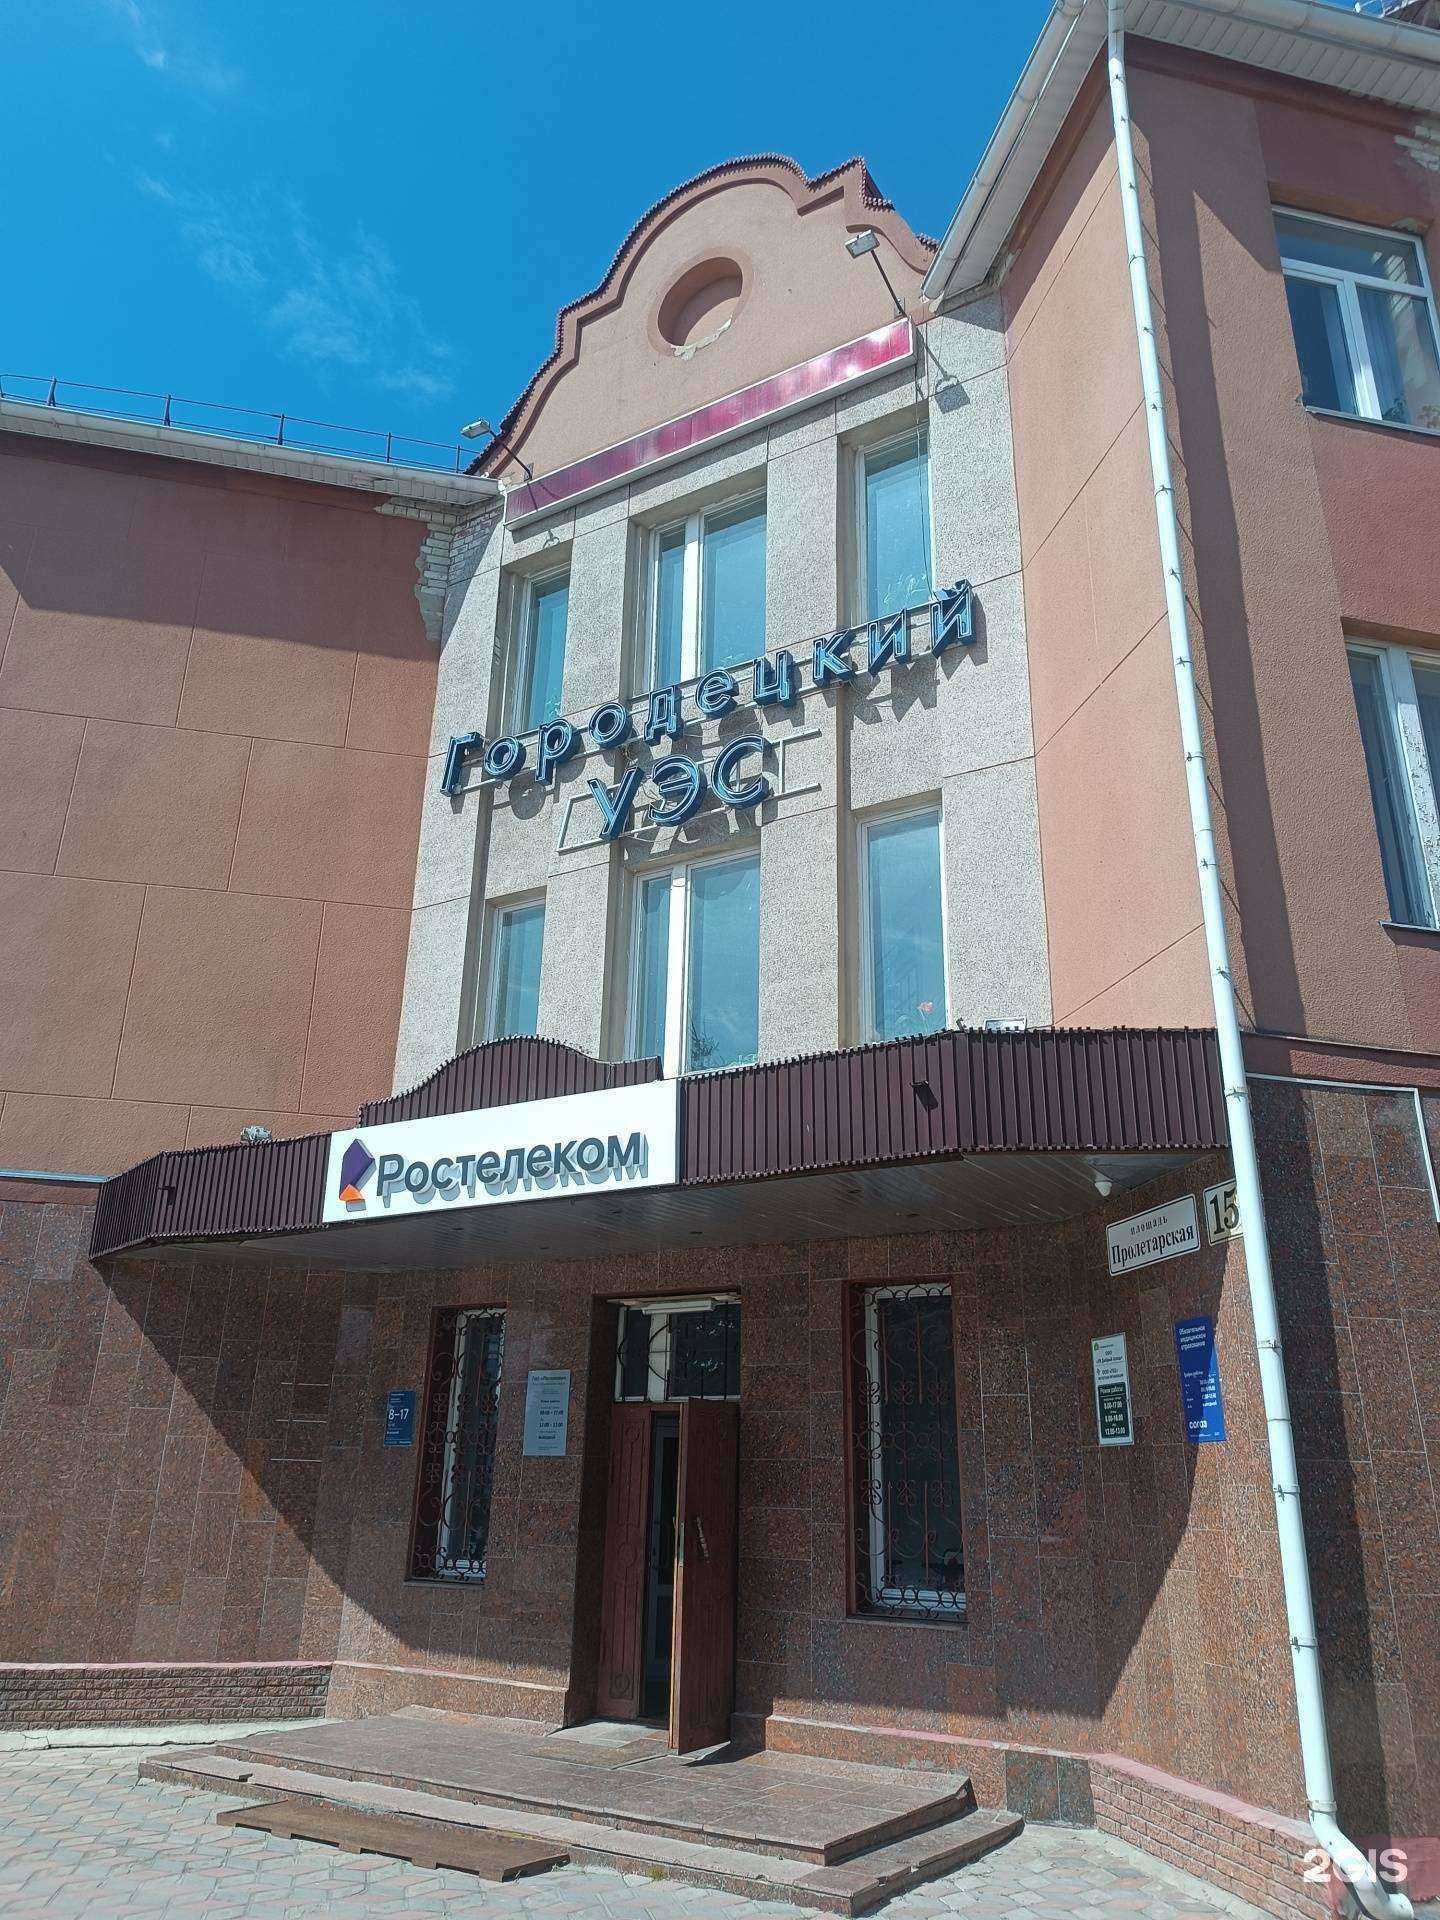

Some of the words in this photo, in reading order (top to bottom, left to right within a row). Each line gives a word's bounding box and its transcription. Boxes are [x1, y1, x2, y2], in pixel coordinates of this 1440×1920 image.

[439, 578, 978, 797] Городецкий
[586, 734, 775, 842] УЭС
[376, 1132, 644, 1200] Ростелеком
[1130, 1215, 1168, 1236] площадь
[1209, 1187, 1240, 1235] 15
[1111, 1225, 1195, 1267] Пролетарская
